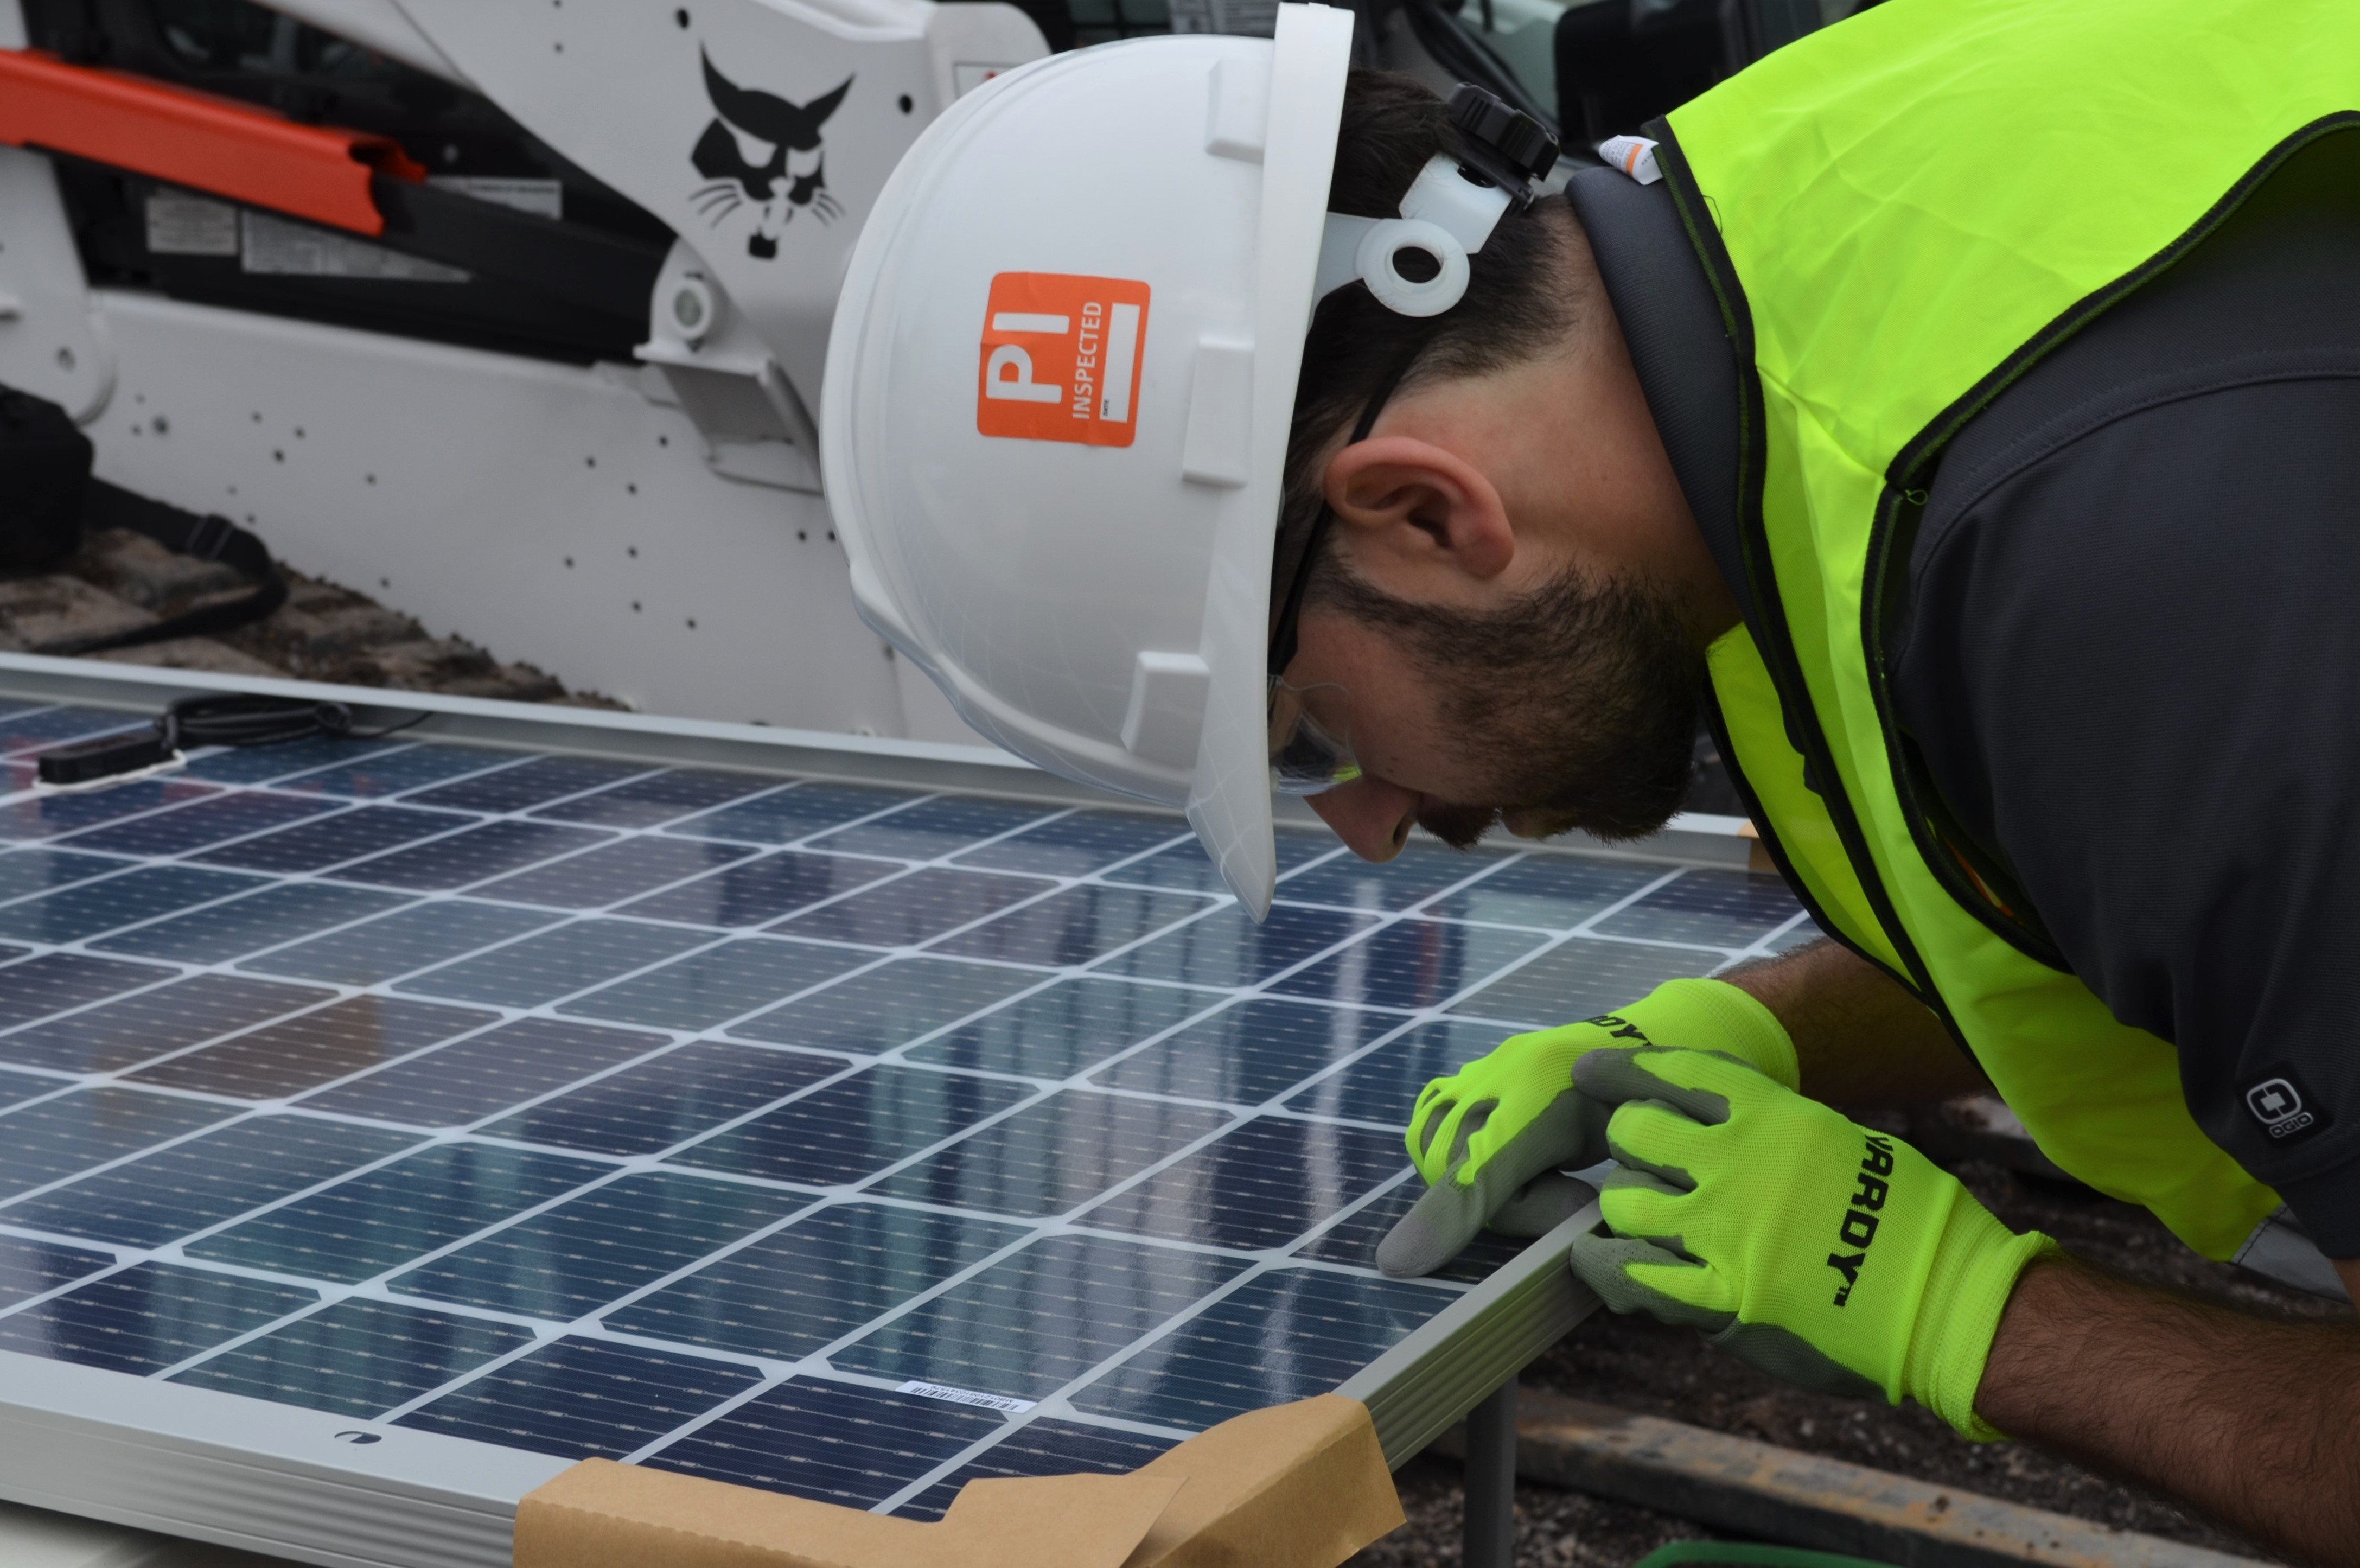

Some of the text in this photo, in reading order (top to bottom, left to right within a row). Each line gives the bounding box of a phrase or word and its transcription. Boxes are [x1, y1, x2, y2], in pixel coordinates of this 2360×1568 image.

[986, 312, 1070, 404] PI
[1072, 301, 1102, 419] INSPECTED
[2269, 1112, 2314, 1138] OGIO
